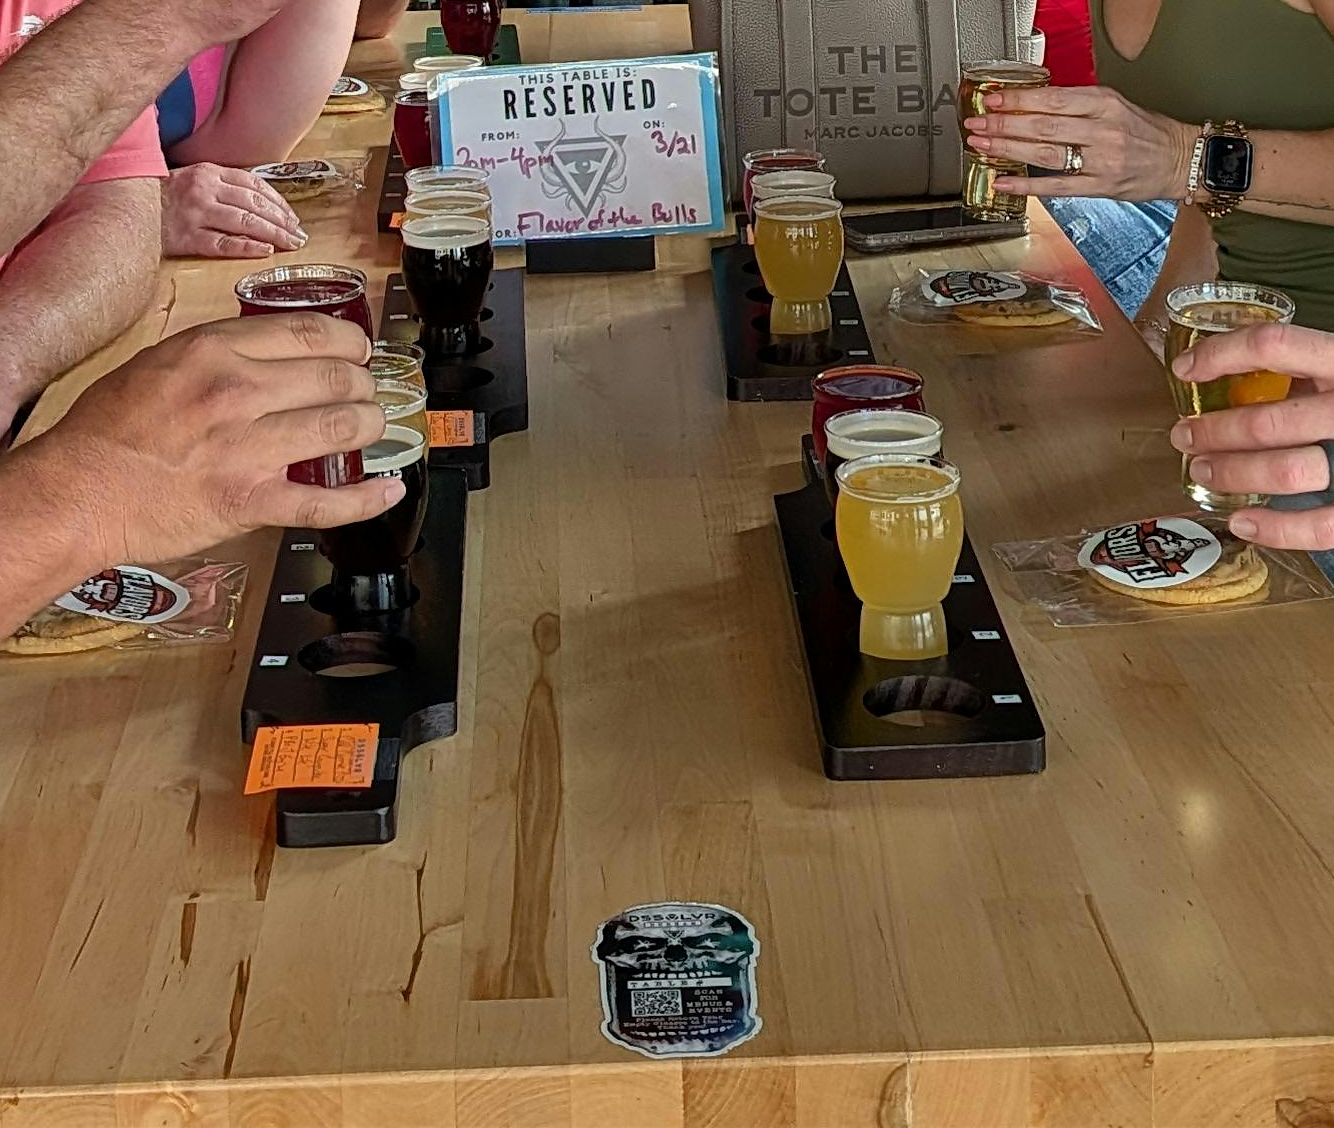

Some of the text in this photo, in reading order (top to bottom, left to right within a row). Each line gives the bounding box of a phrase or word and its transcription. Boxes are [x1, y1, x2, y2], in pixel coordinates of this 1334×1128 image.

[827, 45, 917, 74] THE
[518, 67, 637, 86] THIS TABLE IS:
[503, 78, 656, 120] RESERVED
[754, 83, 958, 118] TOTE BA
[481, 130, 520, 142] FROM:
[643, 119, 666, 130] ON:
[804, 124, 944, 140] MARC JACOBS
[651, 130, 697, 156] 3/21
[516, 201, 698, 236] Flavor of the Bulls
[491, 228, 518, 239] OR:
[108, 570, 156, 621] FLAVORS
